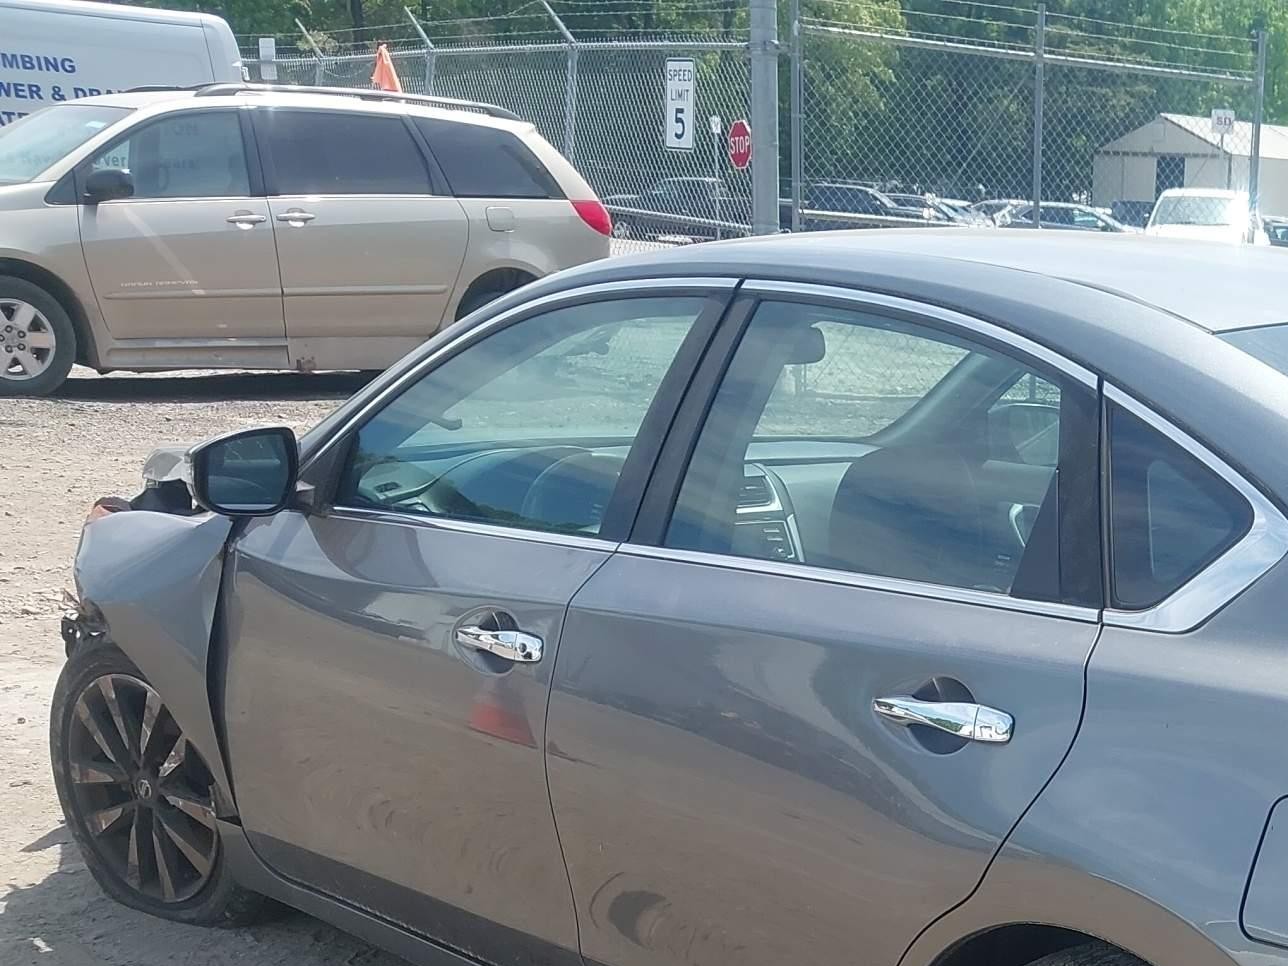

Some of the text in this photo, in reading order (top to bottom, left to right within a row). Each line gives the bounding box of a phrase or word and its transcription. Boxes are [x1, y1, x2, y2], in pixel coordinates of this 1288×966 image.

[668, 69, 692, 82] SPEED
[51, 85, 67, 102] &
[670, 88, 689, 102] LIMIT
[674, 108, 685, 140] 5
[730, 135, 750, 154] STOP
